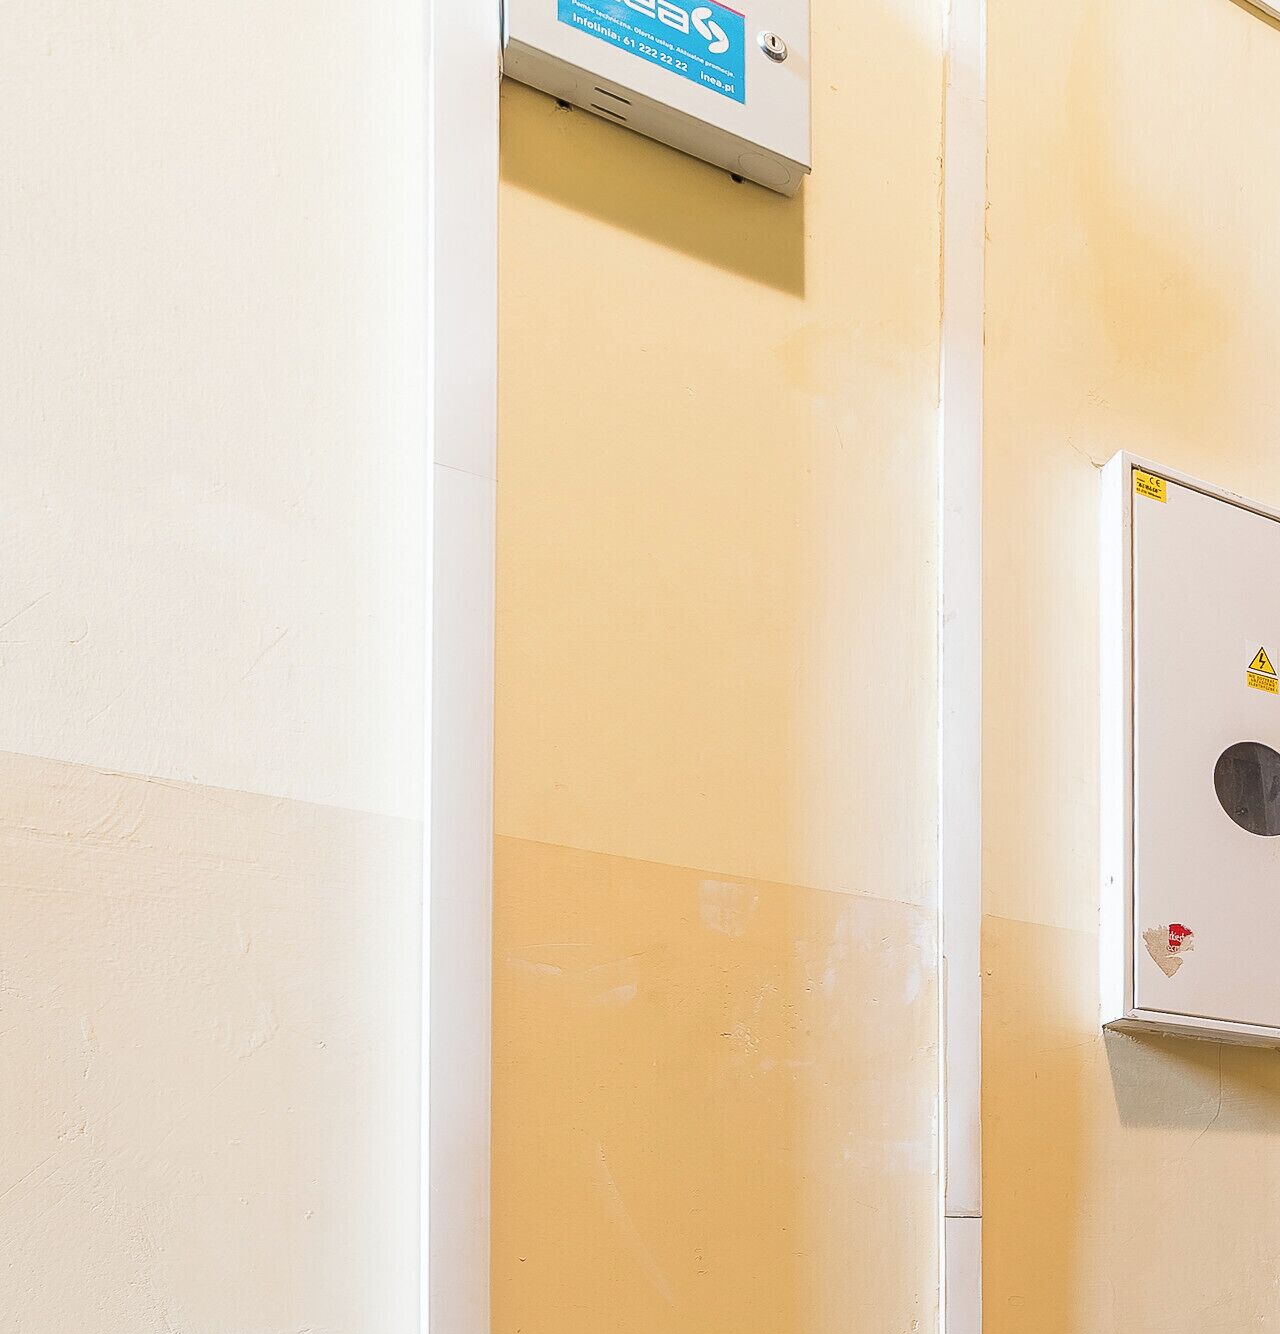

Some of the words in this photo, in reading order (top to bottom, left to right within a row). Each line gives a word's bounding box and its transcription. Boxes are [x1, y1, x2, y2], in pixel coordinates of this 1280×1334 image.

[572, 12, 621, 42] Infolinia:
[623, 36, 635, 48] 61
[638, 42, 658, 58] 222
[660, 52, 673, 65] 22
[675, 59, 688, 72] 22
